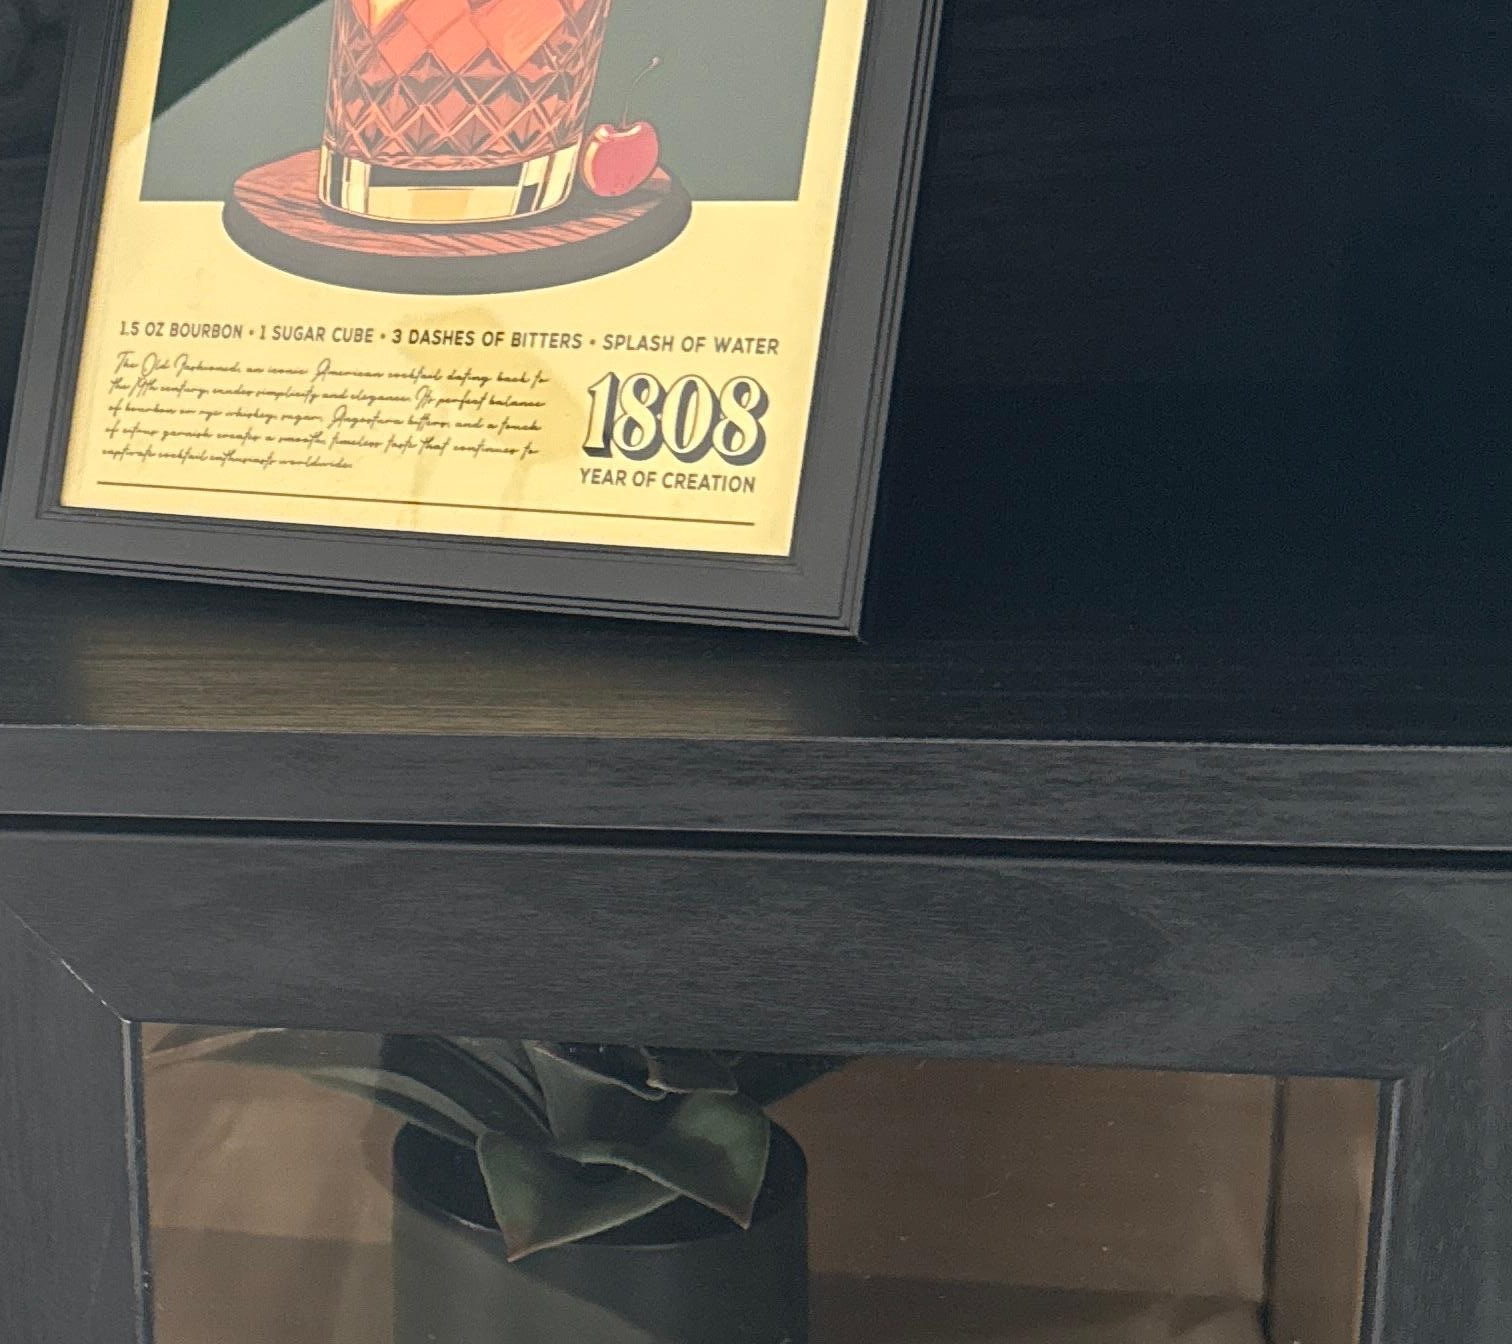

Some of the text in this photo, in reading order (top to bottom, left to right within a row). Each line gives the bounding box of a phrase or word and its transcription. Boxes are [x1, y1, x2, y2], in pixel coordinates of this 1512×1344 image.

[144, 321, 165, 337] OZ
[169, 322, 243, 339] BOURBON
[259, 324, 266, 341] 1
[272, 325, 325, 343] SUGAR
[331, 327, 373, 344] CUBE
[392, 328, 402, 344] 3
[408, 329, 474, 347] DASHES
[481, 331, 505, 347] OF
[511, 332, 582, 349] BITTERS
[602, 333, 672, 352] SPLASH
[681, 335, 706, 353] OF
[714, 336, 779, 355] WATER
[582, 371, 769, 466] 1808
[580, 467, 756, 493] YEAR OF CREATION
